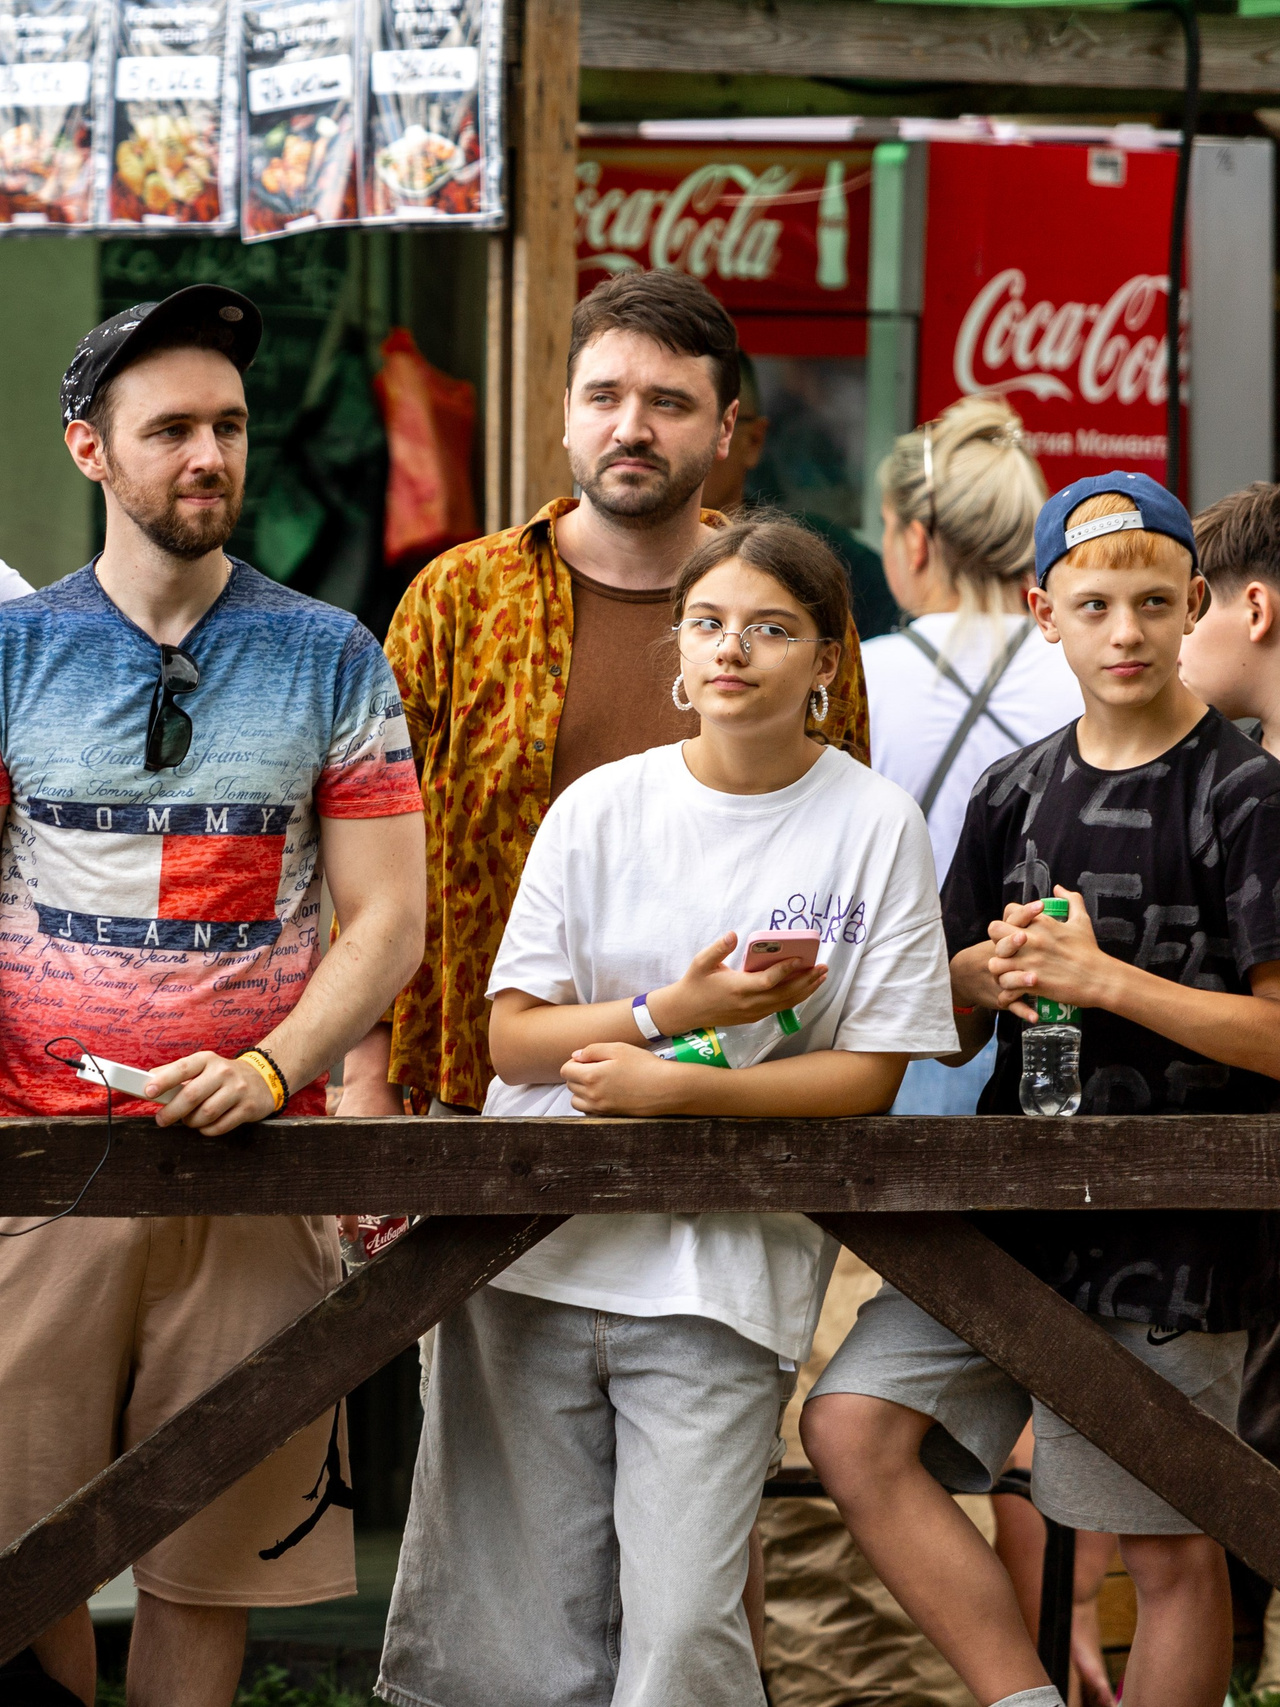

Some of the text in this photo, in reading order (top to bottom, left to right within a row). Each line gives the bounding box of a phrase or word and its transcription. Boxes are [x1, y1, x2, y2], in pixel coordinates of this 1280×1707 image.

[85, 778, 144, 804] Tommy
[141, 779, 197, 805] Jeans
[213, 775, 272, 805] Tommy
[45, 803, 277, 834] TOMMY
[58, 912, 250, 949] JEANS
[83, 965, 141, 999] Tommy
[149, 971, 195, 1001] Jeans
[212, 973, 270, 996] Tommy
[270, 966, 307, 993] Jeans
